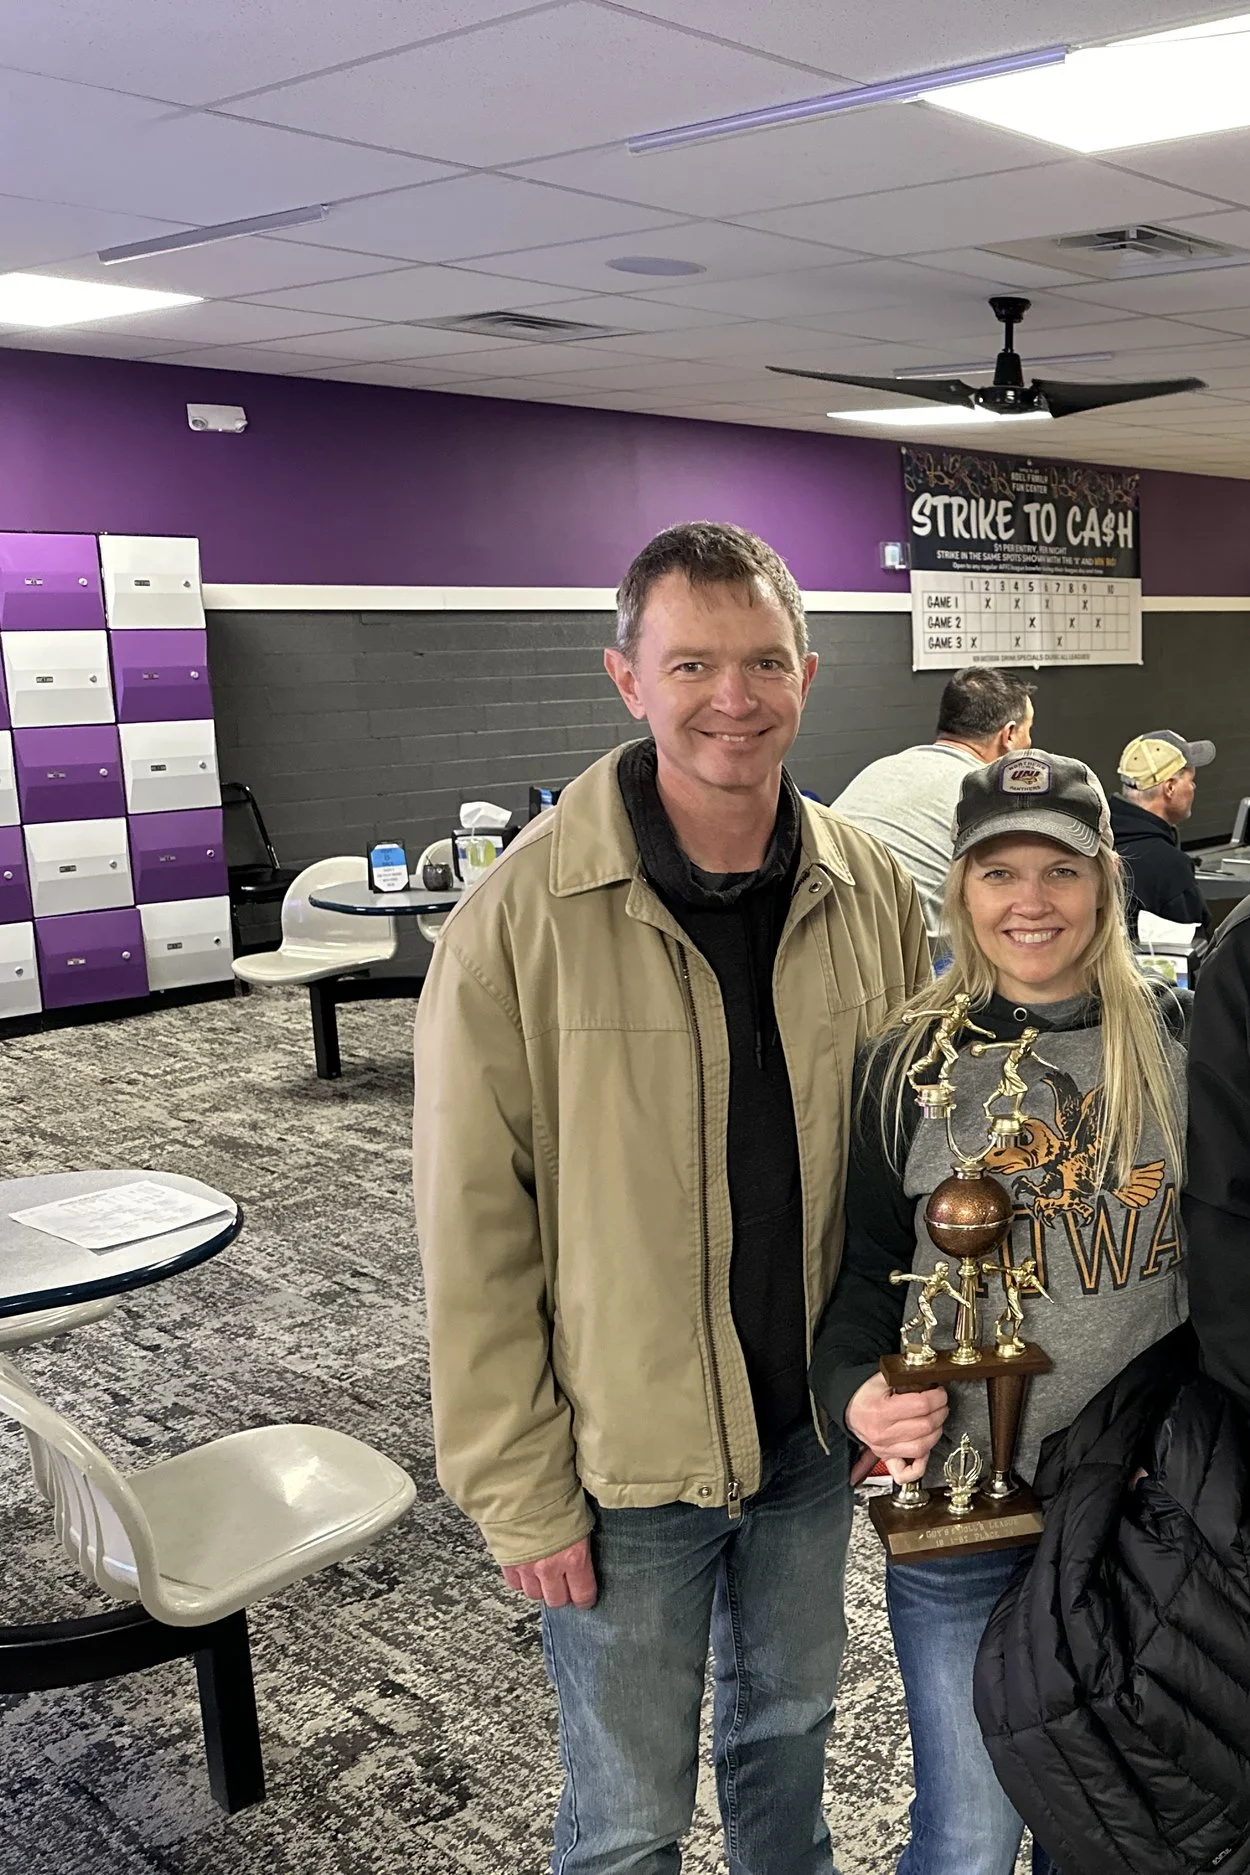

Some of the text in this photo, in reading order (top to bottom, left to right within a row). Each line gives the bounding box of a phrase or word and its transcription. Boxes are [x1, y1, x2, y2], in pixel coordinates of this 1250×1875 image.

[1026, 484, 1047, 494] CENTER
[911, 492, 1133, 548] STRIKE TO CA$H
[936, 550, 960, 559] STRIKE
[961, 551, 968, 560] IN
[969, 552, 981, 560] THE
[982, 552, 1001, 561] SAME
[1002, 553, 1022, 562] SPOTS
[1023, 554, 1046, 562] SHOWN
[1046, 556, 1060, 564] WITH
[1062, 556, 1072, 564] THE
[985, 581, 990, 591] 2
[1000, 582, 1005, 591] 3
[1013, 582, 1019, 591] 4
[1029, 582, 1034, 592] 5
[1044, 583, 1048, 592] 6
[1056, 584, 1060, 592] 7
[1069, 584, 1074, 593] 8
[1082, 584, 1087, 593] 9
[1108, 585, 1114, 594] 10
[927, 598, 953, 608] GAME
[955, 597, 958, 608] 1
[985, 598, 991, 609] X
[1014, 598, 1020, 609] X
[1082, 600, 1088, 610] X
[928, 616, 1101, 628] GAME 2 X X X
[928, 636, 1062, 648] GAME 3 X X X
[1009, 762, 1045, 770] NORTHERN
[1011, 770, 1041, 780] UNI
[976, 1183, 1183, 1298] OWA
[974, 1531, 1000, 1541] PLACE
